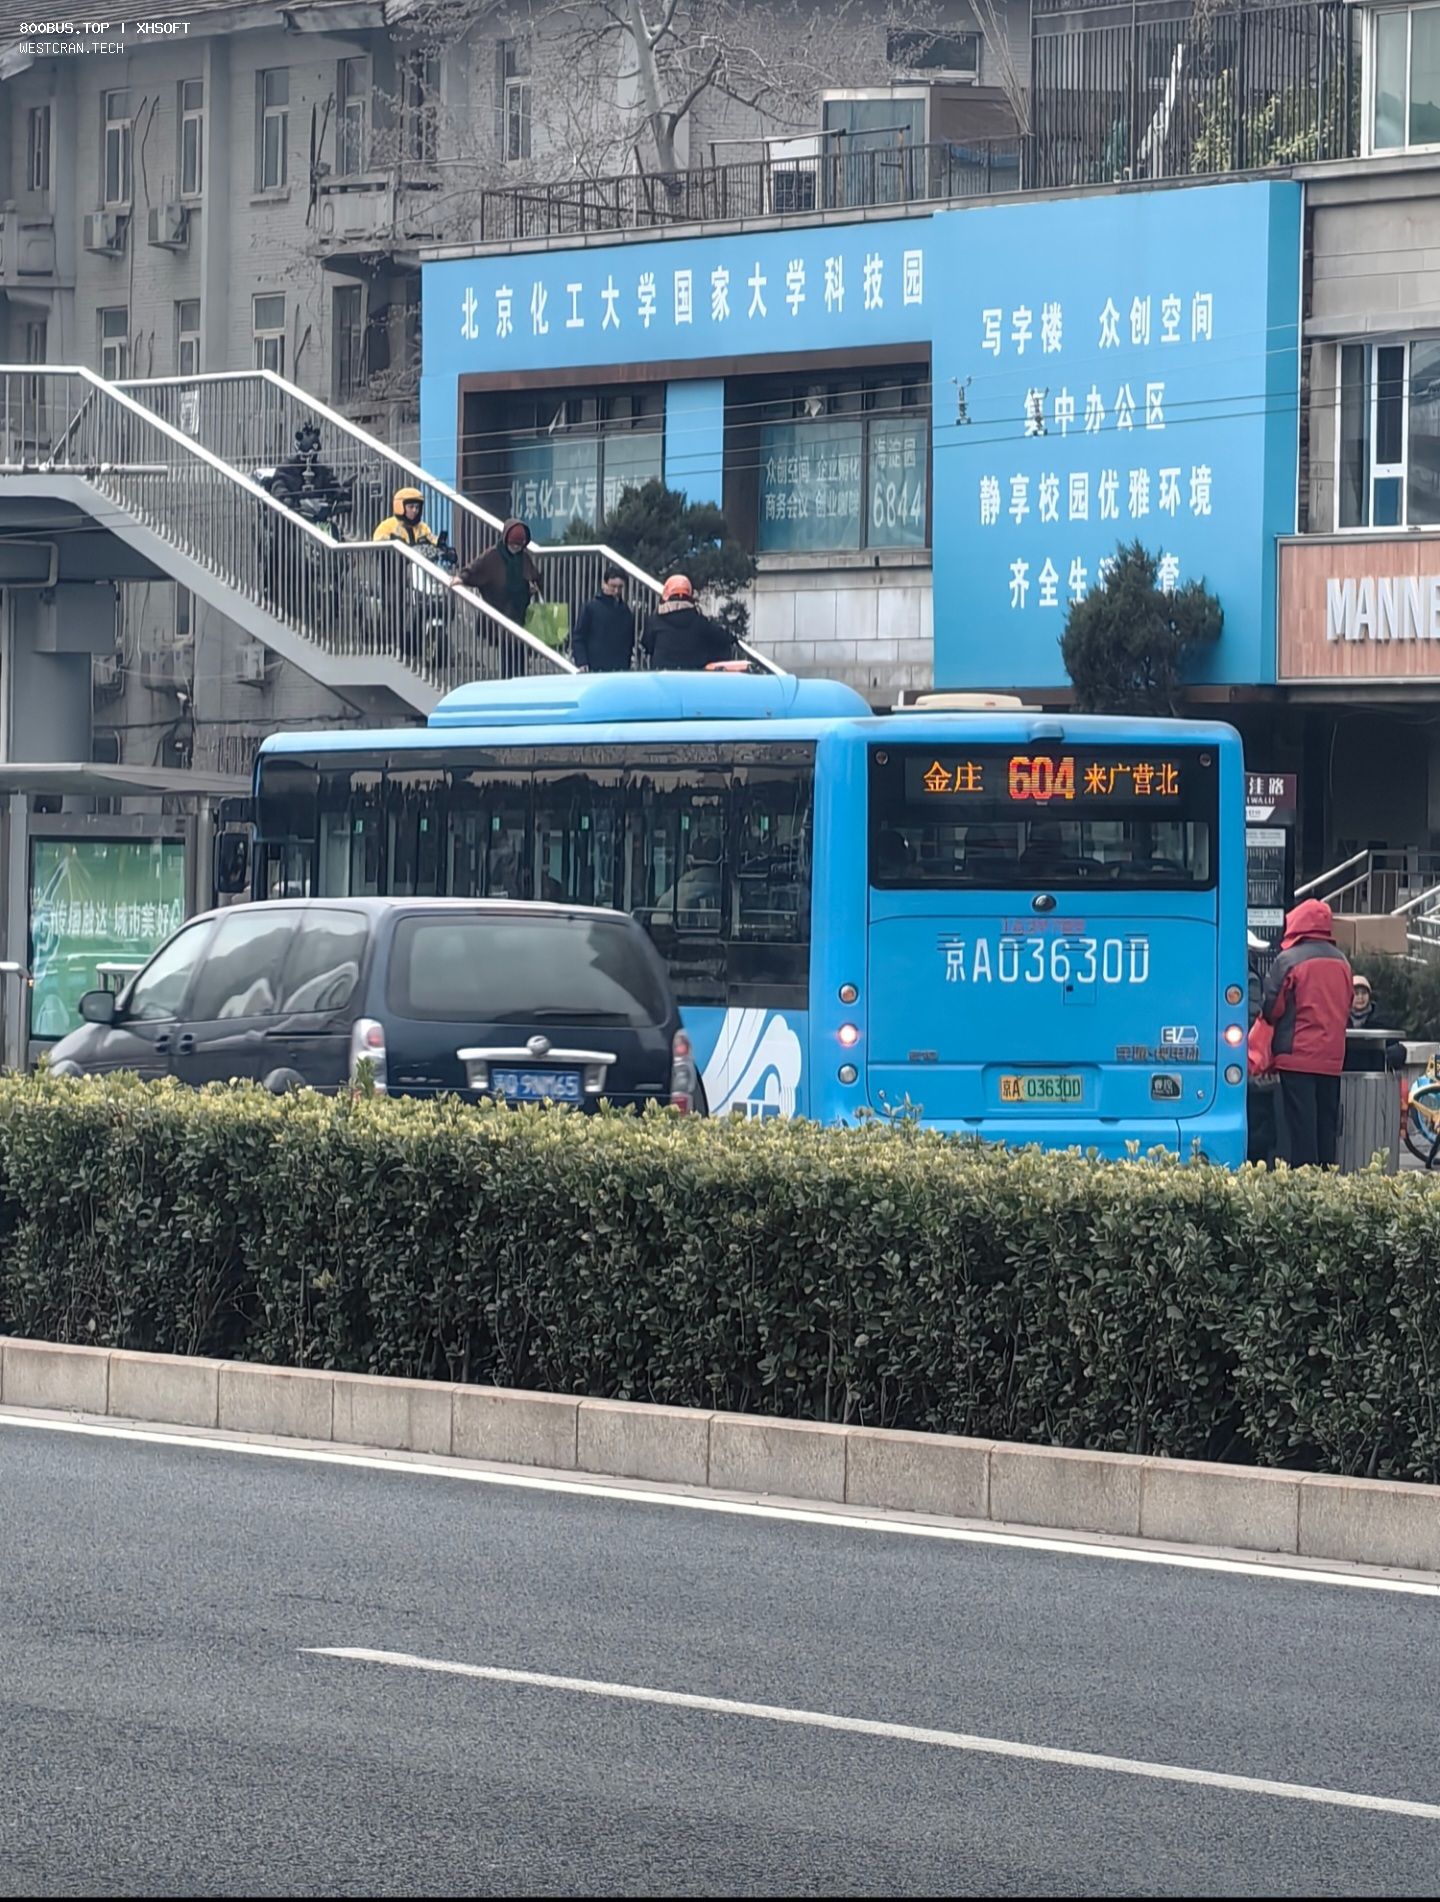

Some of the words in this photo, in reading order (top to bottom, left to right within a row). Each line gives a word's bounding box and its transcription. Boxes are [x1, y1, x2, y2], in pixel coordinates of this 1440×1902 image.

[460, 248, 924, 340] 北京化工大学国家大学科技园
[981, 301, 1063, 357] 写字楼
[1098, 290, 1213, 349] 众创空间
[1023, 381, 1166, 438] 集中办公区
[873, 481, 921, 528] 6844
[979, 464, 1213, 526] 静享校园优雅环境
[1008, 552, 1180, 609] 齐全生套
[923, 760, 984, 794] 金庄
[1008, 756, 1076, 800] 604
[1083, 762, 1179, 795] 来广营北
[1248, 776, 1285, 796] 洼路
[945, 937, 1149, 984] 京A03630D
